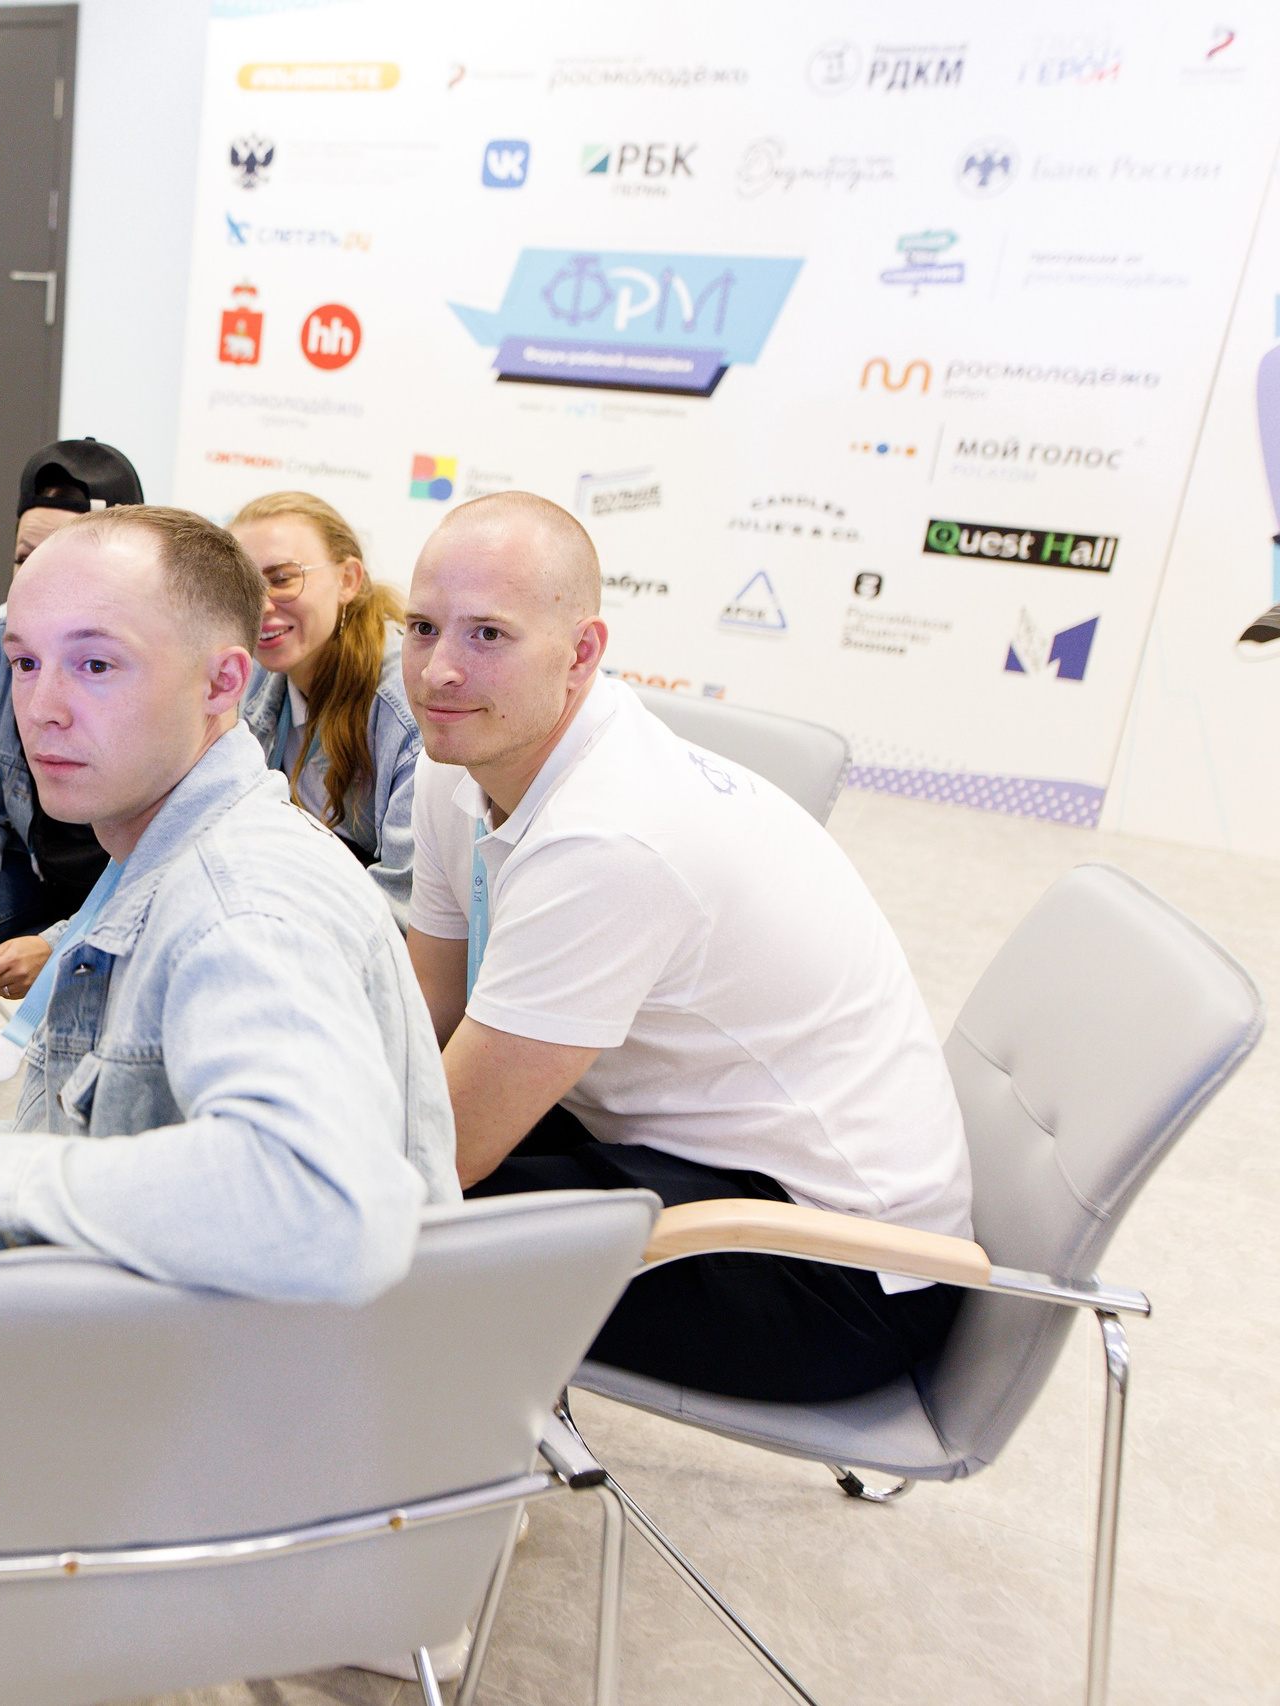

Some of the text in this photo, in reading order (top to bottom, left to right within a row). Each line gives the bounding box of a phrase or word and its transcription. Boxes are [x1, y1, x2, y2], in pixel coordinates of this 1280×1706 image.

[867, 57, 967, 93] РДКМ
[616, 143, 699, 178] РБК
[540, 254, 737, 336] ФРМ
[307, 315, 354, 356] hh
[942, 358, 1162, 389] росмолодёжь
[955, 435, 1123, 471] МОЙ ГОЛОС
[927, 520, 1117, 569] Quest Hall
